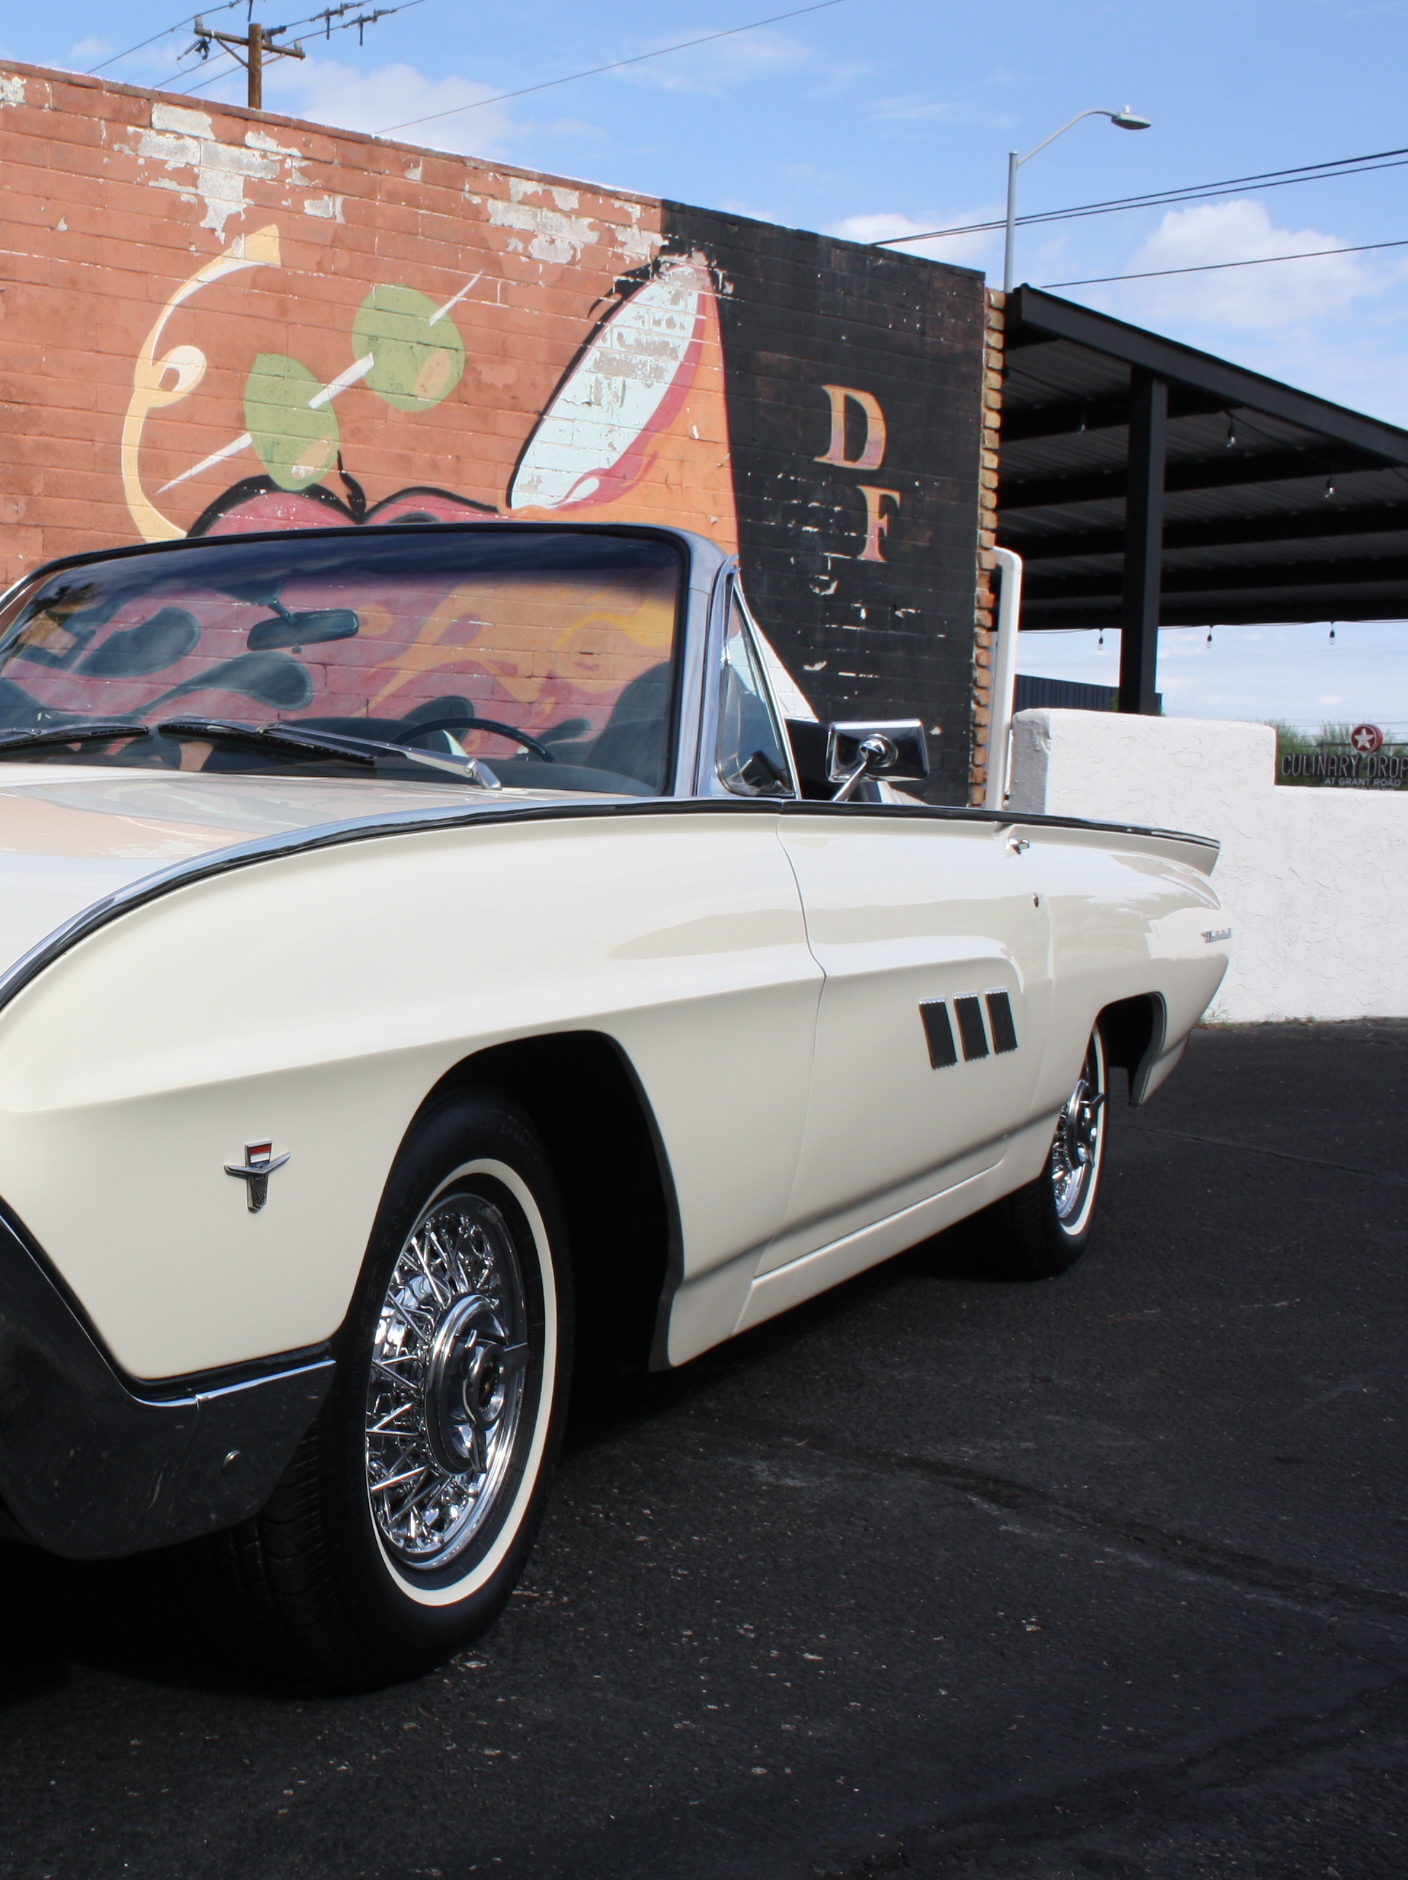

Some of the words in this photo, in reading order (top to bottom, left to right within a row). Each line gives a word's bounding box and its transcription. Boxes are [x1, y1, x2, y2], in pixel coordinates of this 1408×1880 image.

[813, 384, 887, 470] D
[856, 485, 901, 563] F
[1281, 755, 1360, 777] CULINARY
[1323, 777, 1337, 785] AT
[1338, 777, 1371, 786] GRANT
[1373, 778, 1402, 787] ROAD
